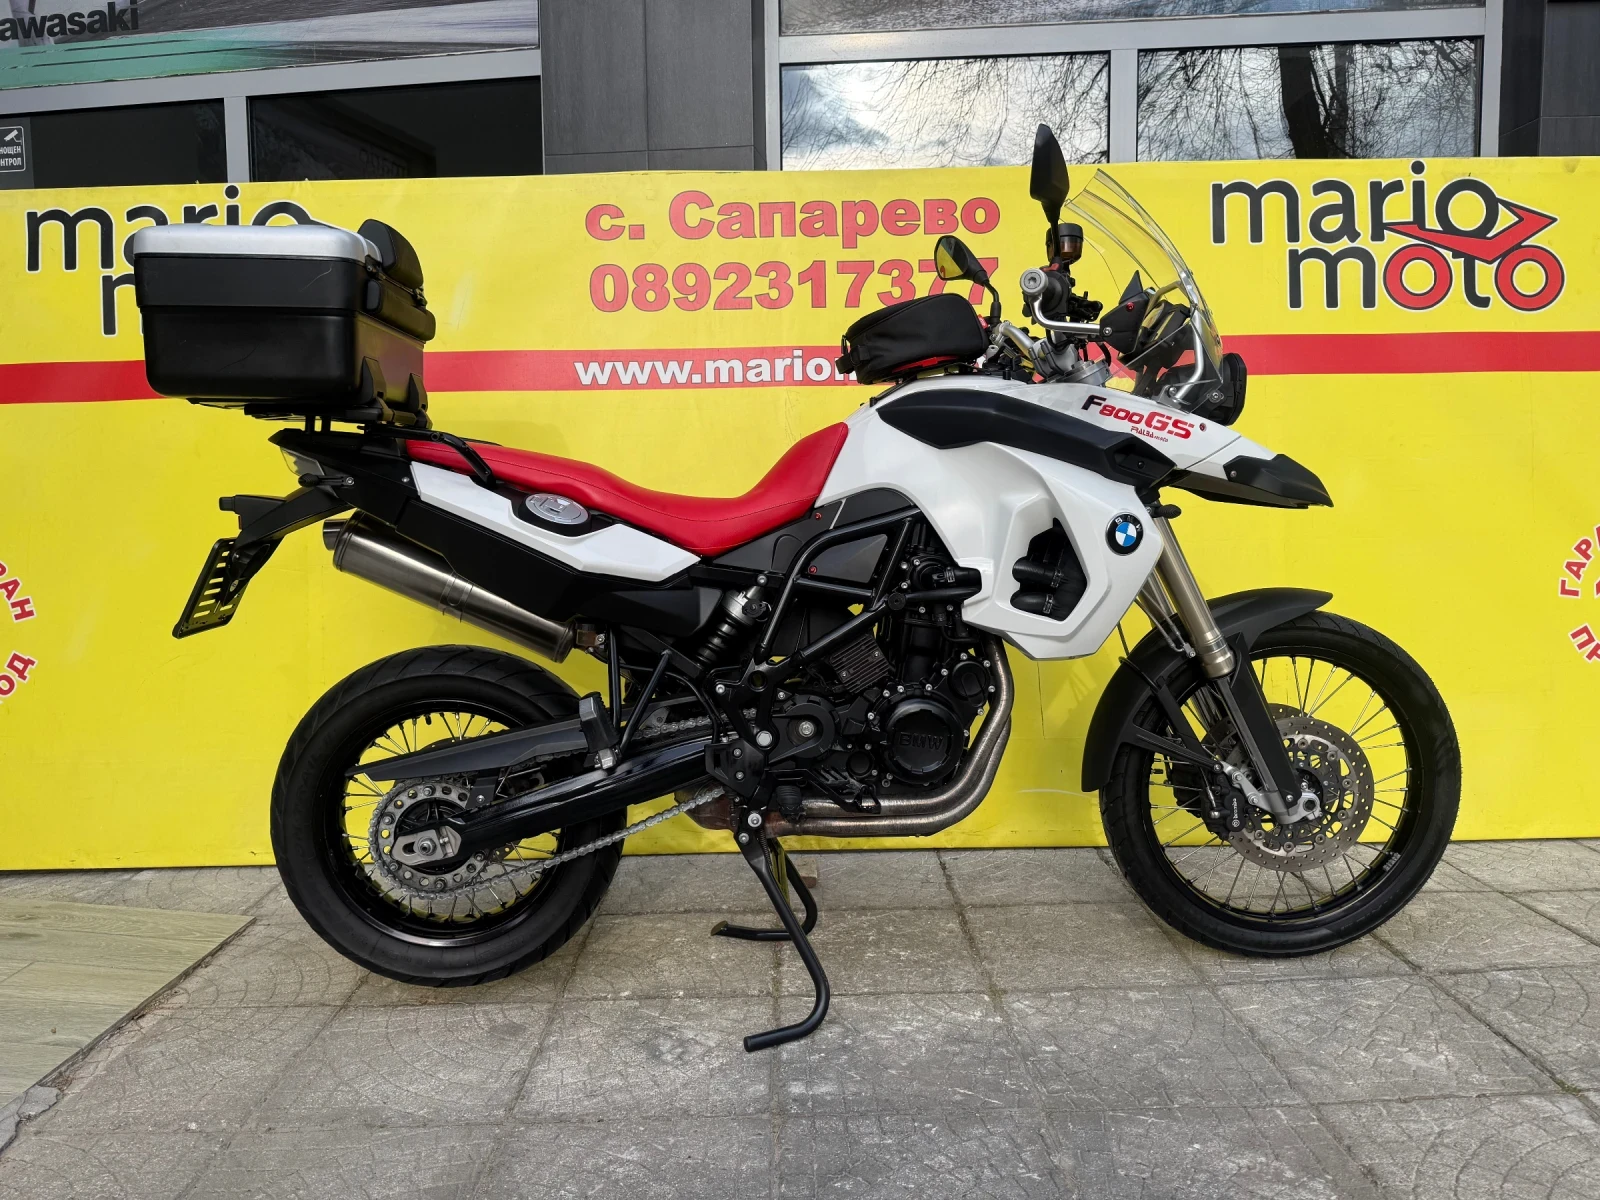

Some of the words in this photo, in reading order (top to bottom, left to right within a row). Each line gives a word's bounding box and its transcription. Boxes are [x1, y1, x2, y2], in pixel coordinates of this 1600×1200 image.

[585, 203, 646, 241] с.
[668, 190, 1001, 249] Сапарево
[1211, 160, 1500, 244] mario
[1289, 243, 1566, 311] moto
[1559, 525, 1600, 598] ГАР
[899, 731, 944, 751] BMW
